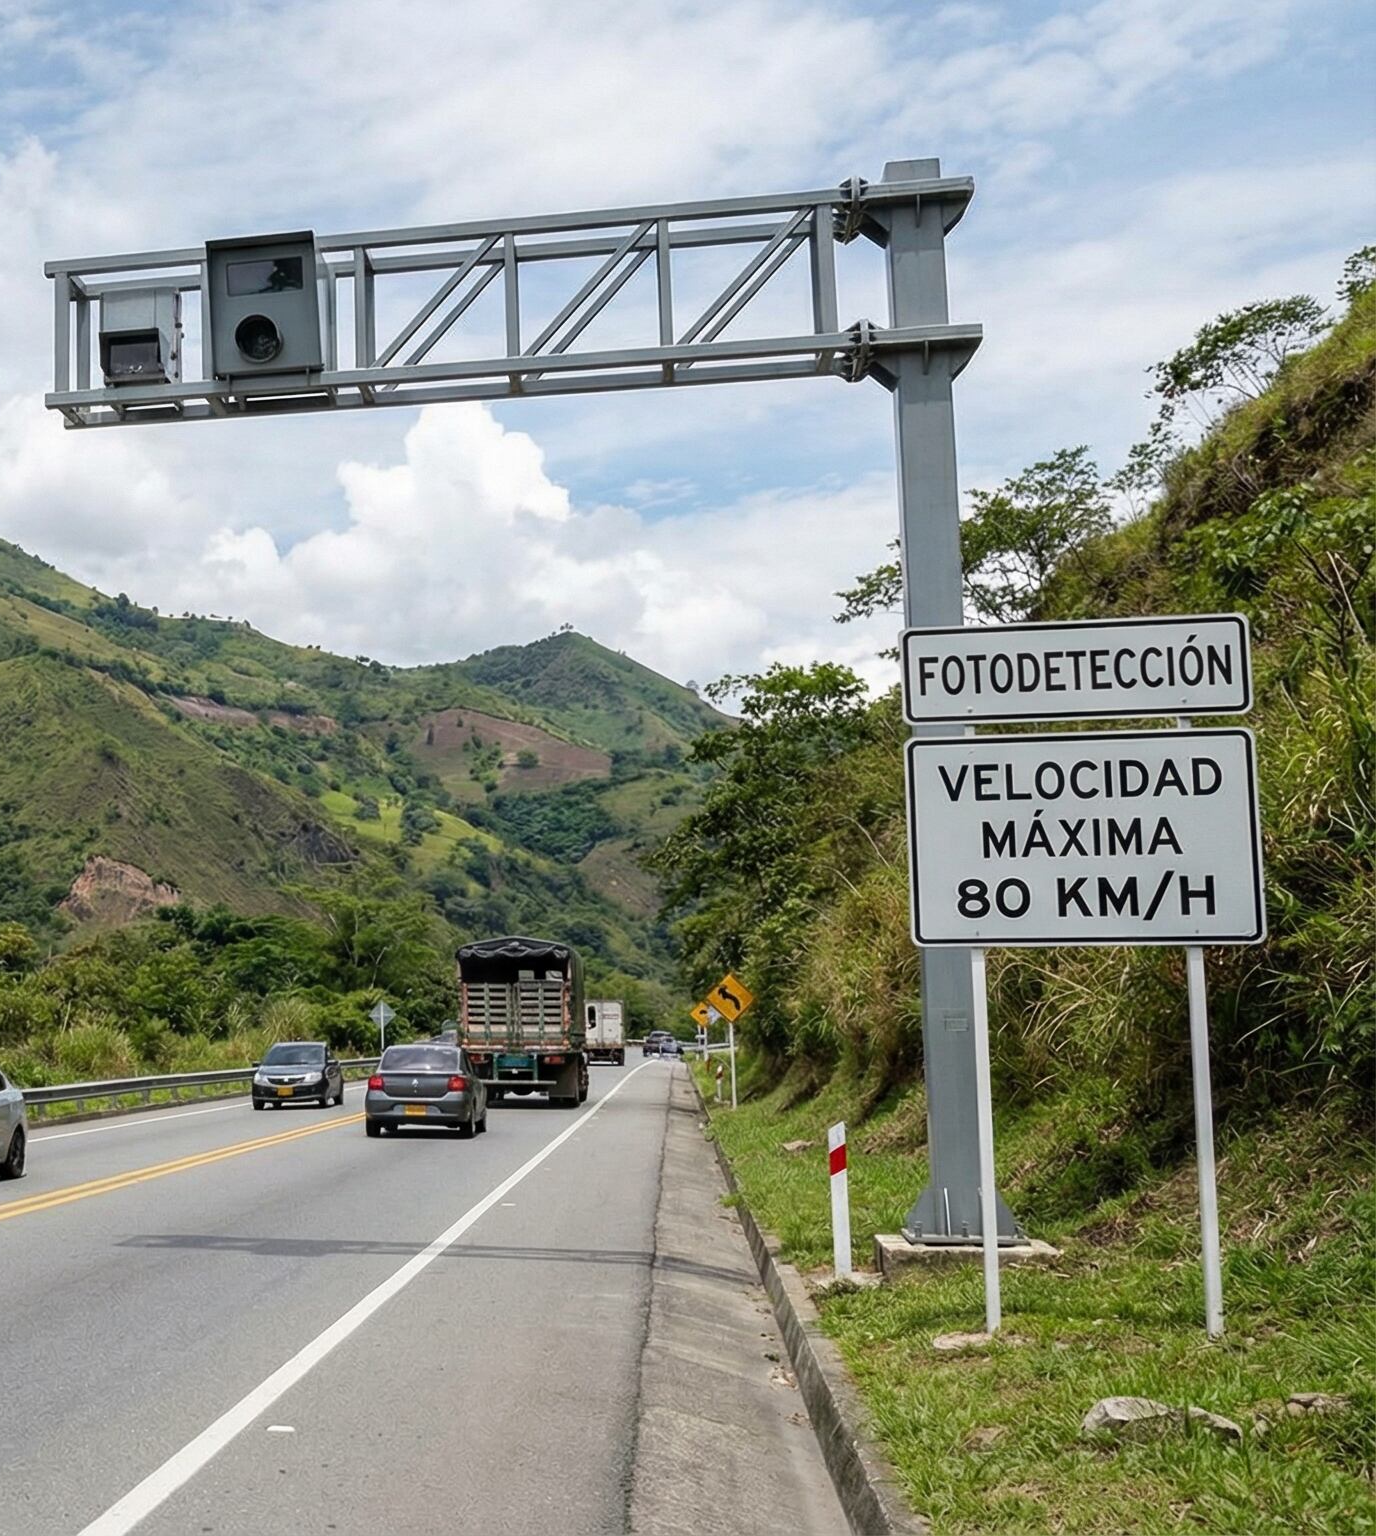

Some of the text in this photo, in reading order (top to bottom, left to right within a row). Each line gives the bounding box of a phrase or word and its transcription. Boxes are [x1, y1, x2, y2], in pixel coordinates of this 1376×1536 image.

[918, 634, 1234, 697] FOTODETECCIÓN
[937, 757, 1224, 802] VELOCIDAD
[981, 808, 1185, 859] MÁXIMA
[956, 869, 1217, 921] 80 KM/H
